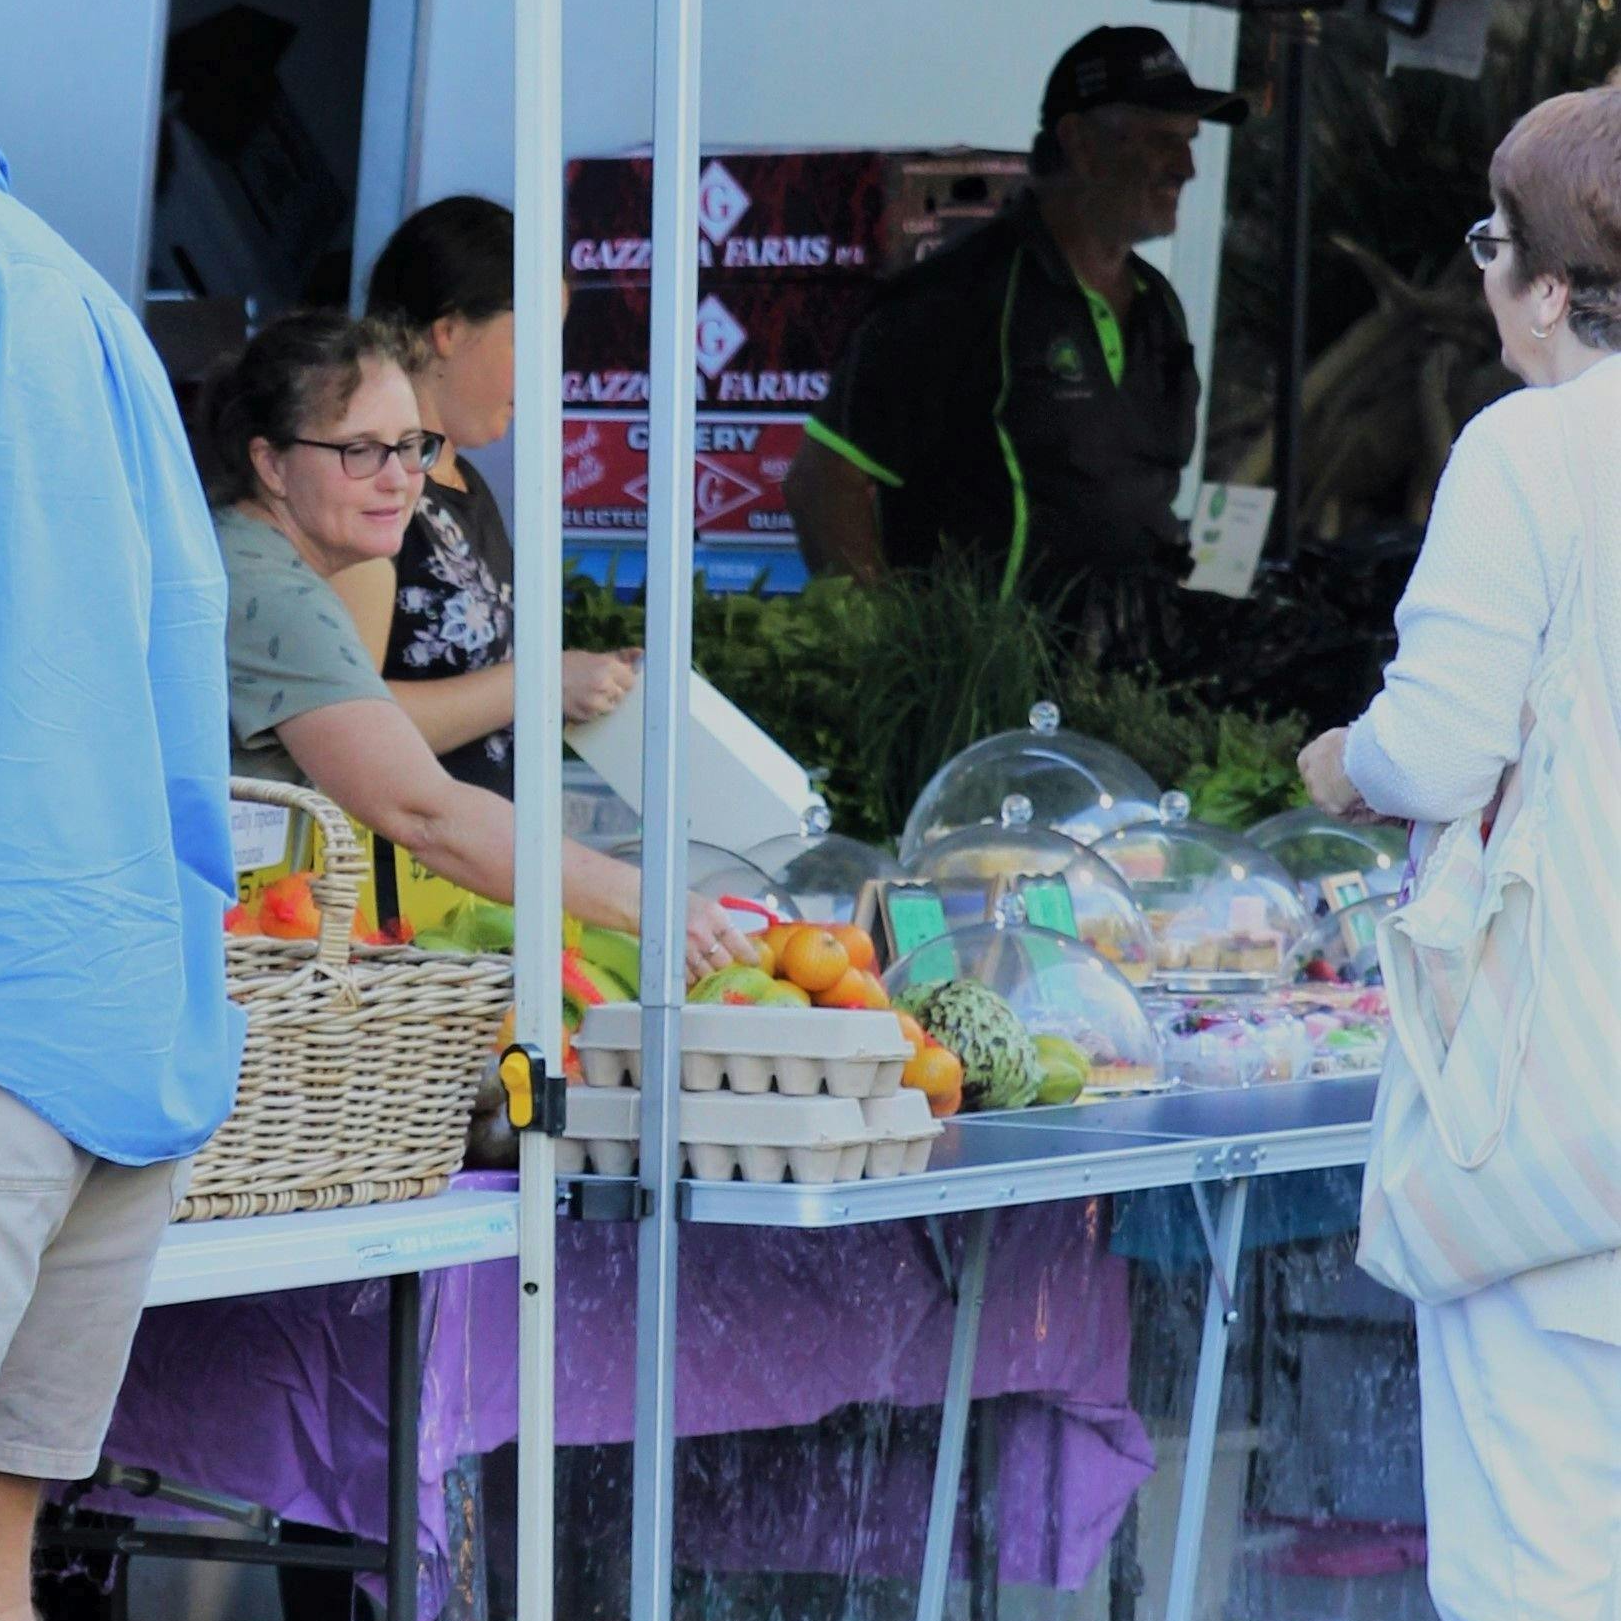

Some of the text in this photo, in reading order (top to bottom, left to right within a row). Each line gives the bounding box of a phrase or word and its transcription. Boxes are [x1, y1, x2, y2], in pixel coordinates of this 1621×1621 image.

[570, 237, 714, 270] GAZZA
[723, 234, 832, 268] FARMS
[718, 369, 831, 402] FARMS
[626, 422, 761, 453] CERY
[562, 507, 648, 528] ELECTED
